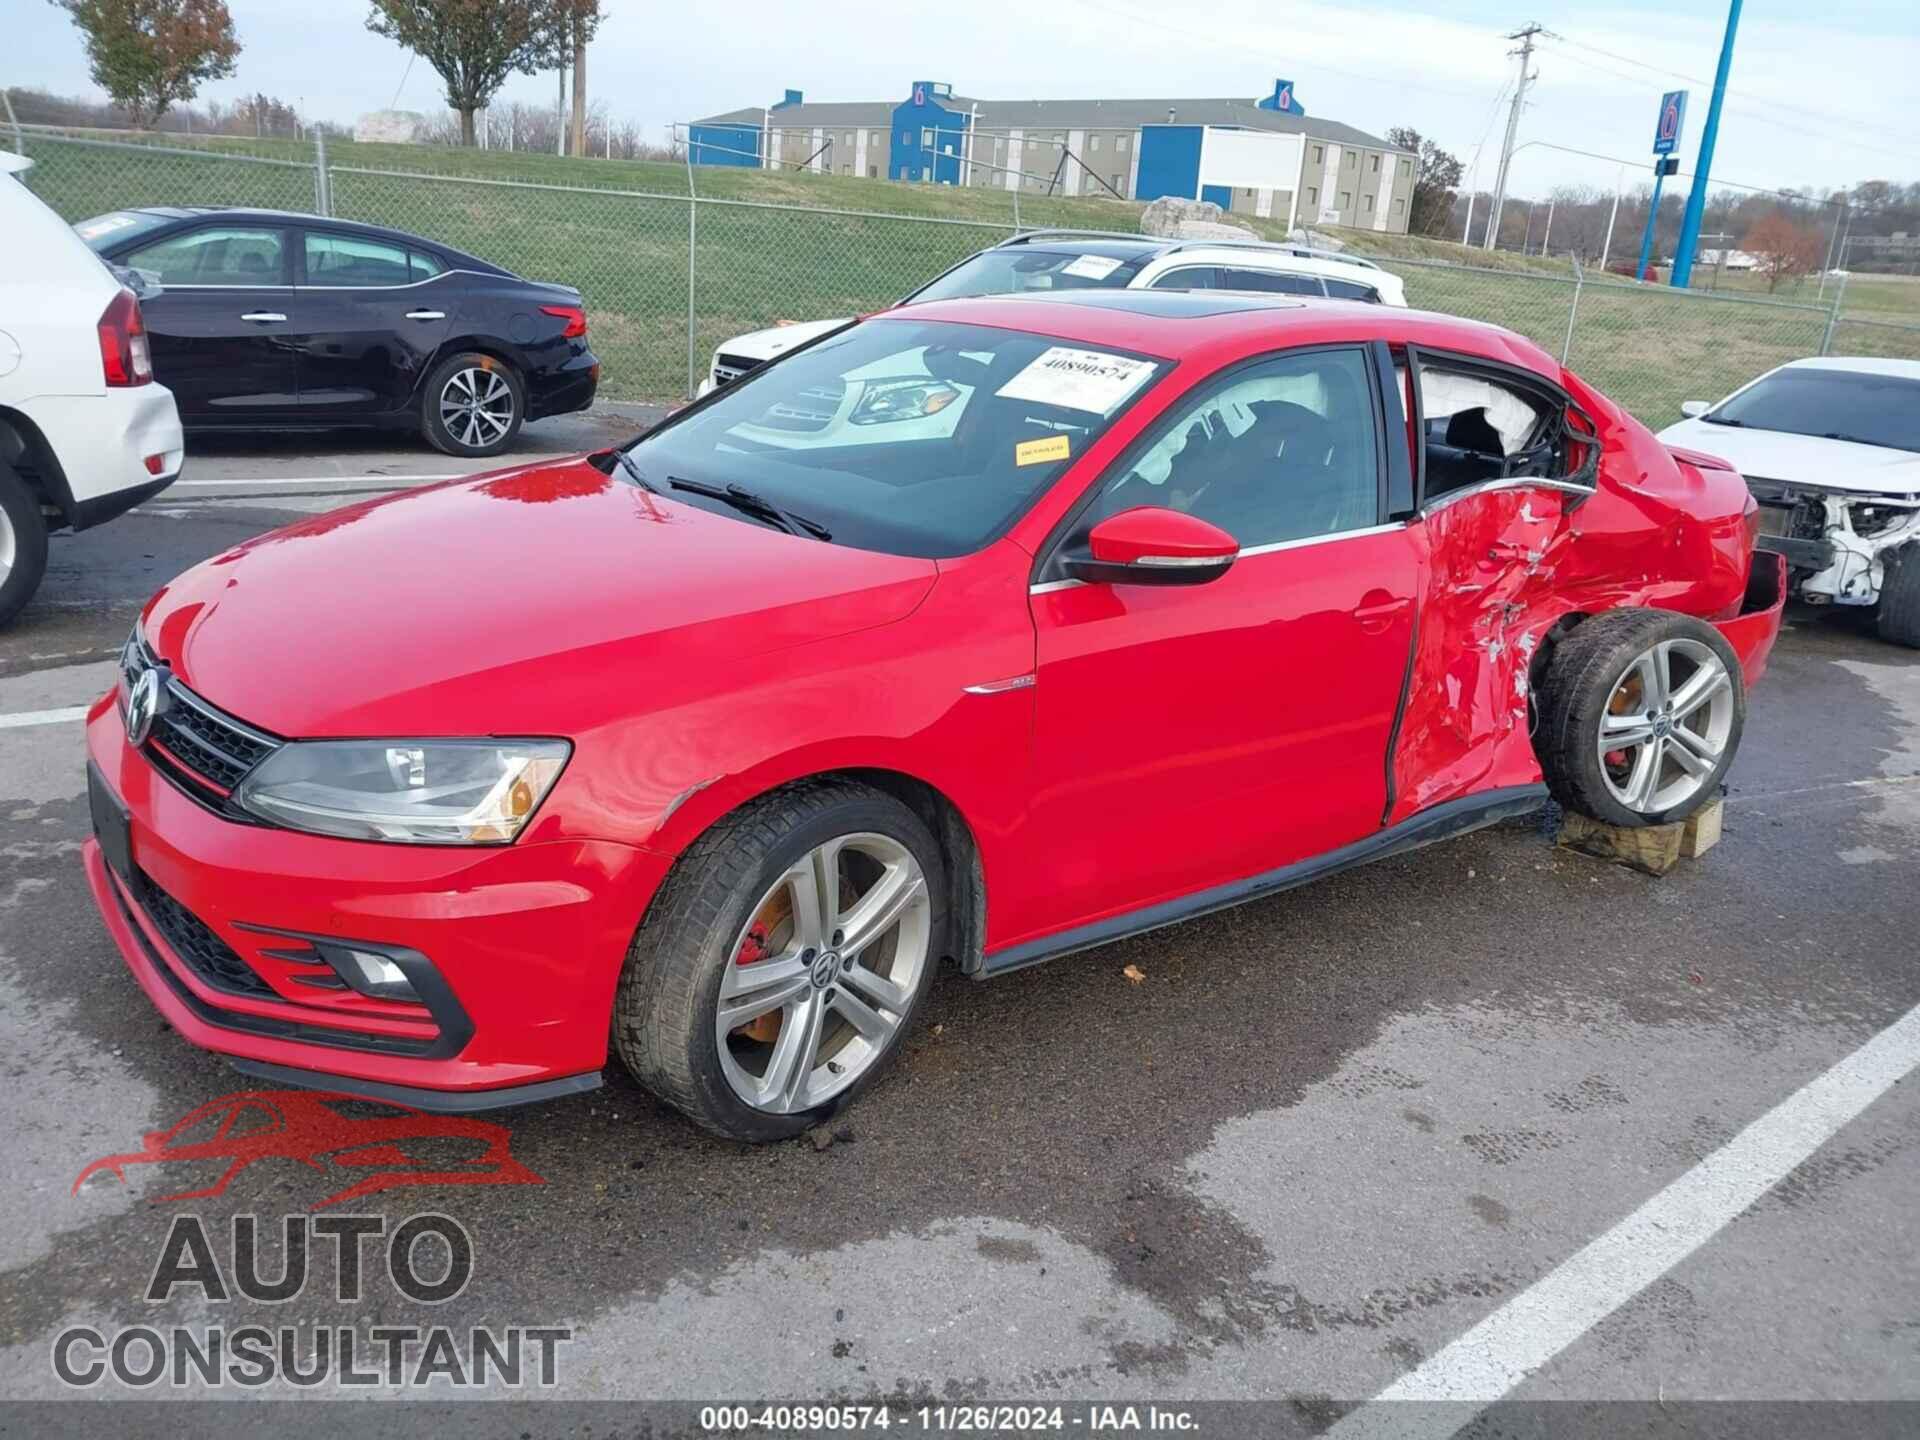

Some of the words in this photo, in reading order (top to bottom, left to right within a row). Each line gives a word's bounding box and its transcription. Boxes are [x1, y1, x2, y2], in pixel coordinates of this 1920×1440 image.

[914, 84, 924, 106] 6
[1279, 85, 1290, 109] 6
[1661, 94, 1678, 140] 6
[1044, 358, 1131, 381] 40890574
